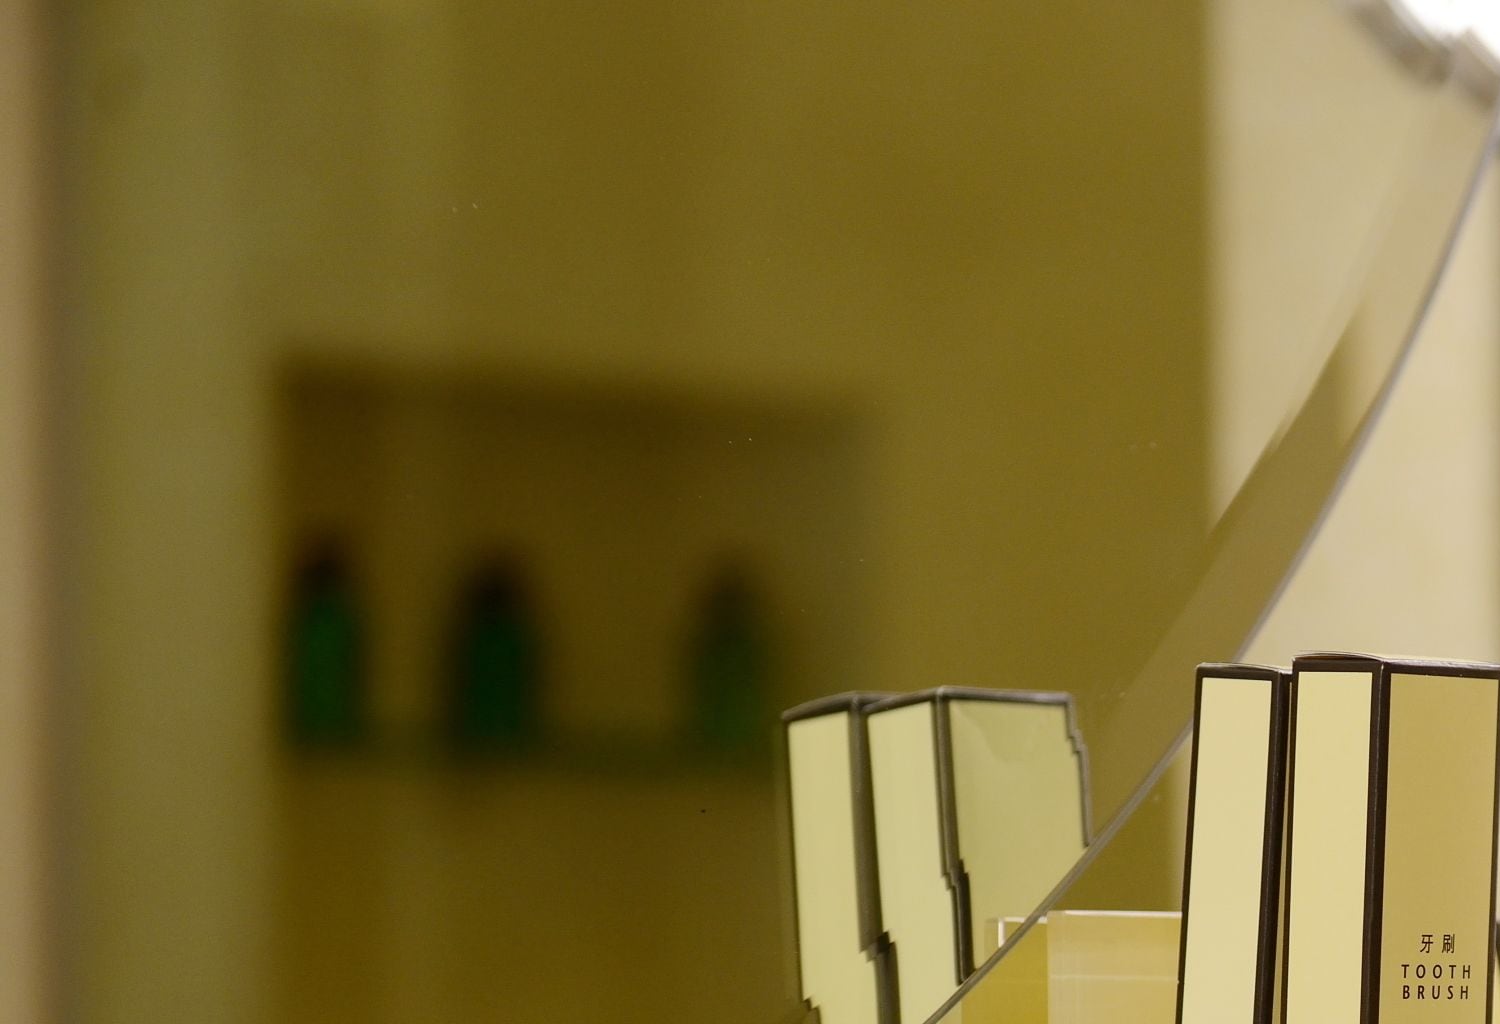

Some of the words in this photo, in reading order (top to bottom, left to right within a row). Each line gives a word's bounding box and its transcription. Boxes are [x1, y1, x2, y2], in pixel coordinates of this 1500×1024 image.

[1419, 933, 1456, 954] 牙刷
[1400, 963, 1471, 979] TOOTH
[1401, 984, 1469, 1000] BRUSH
